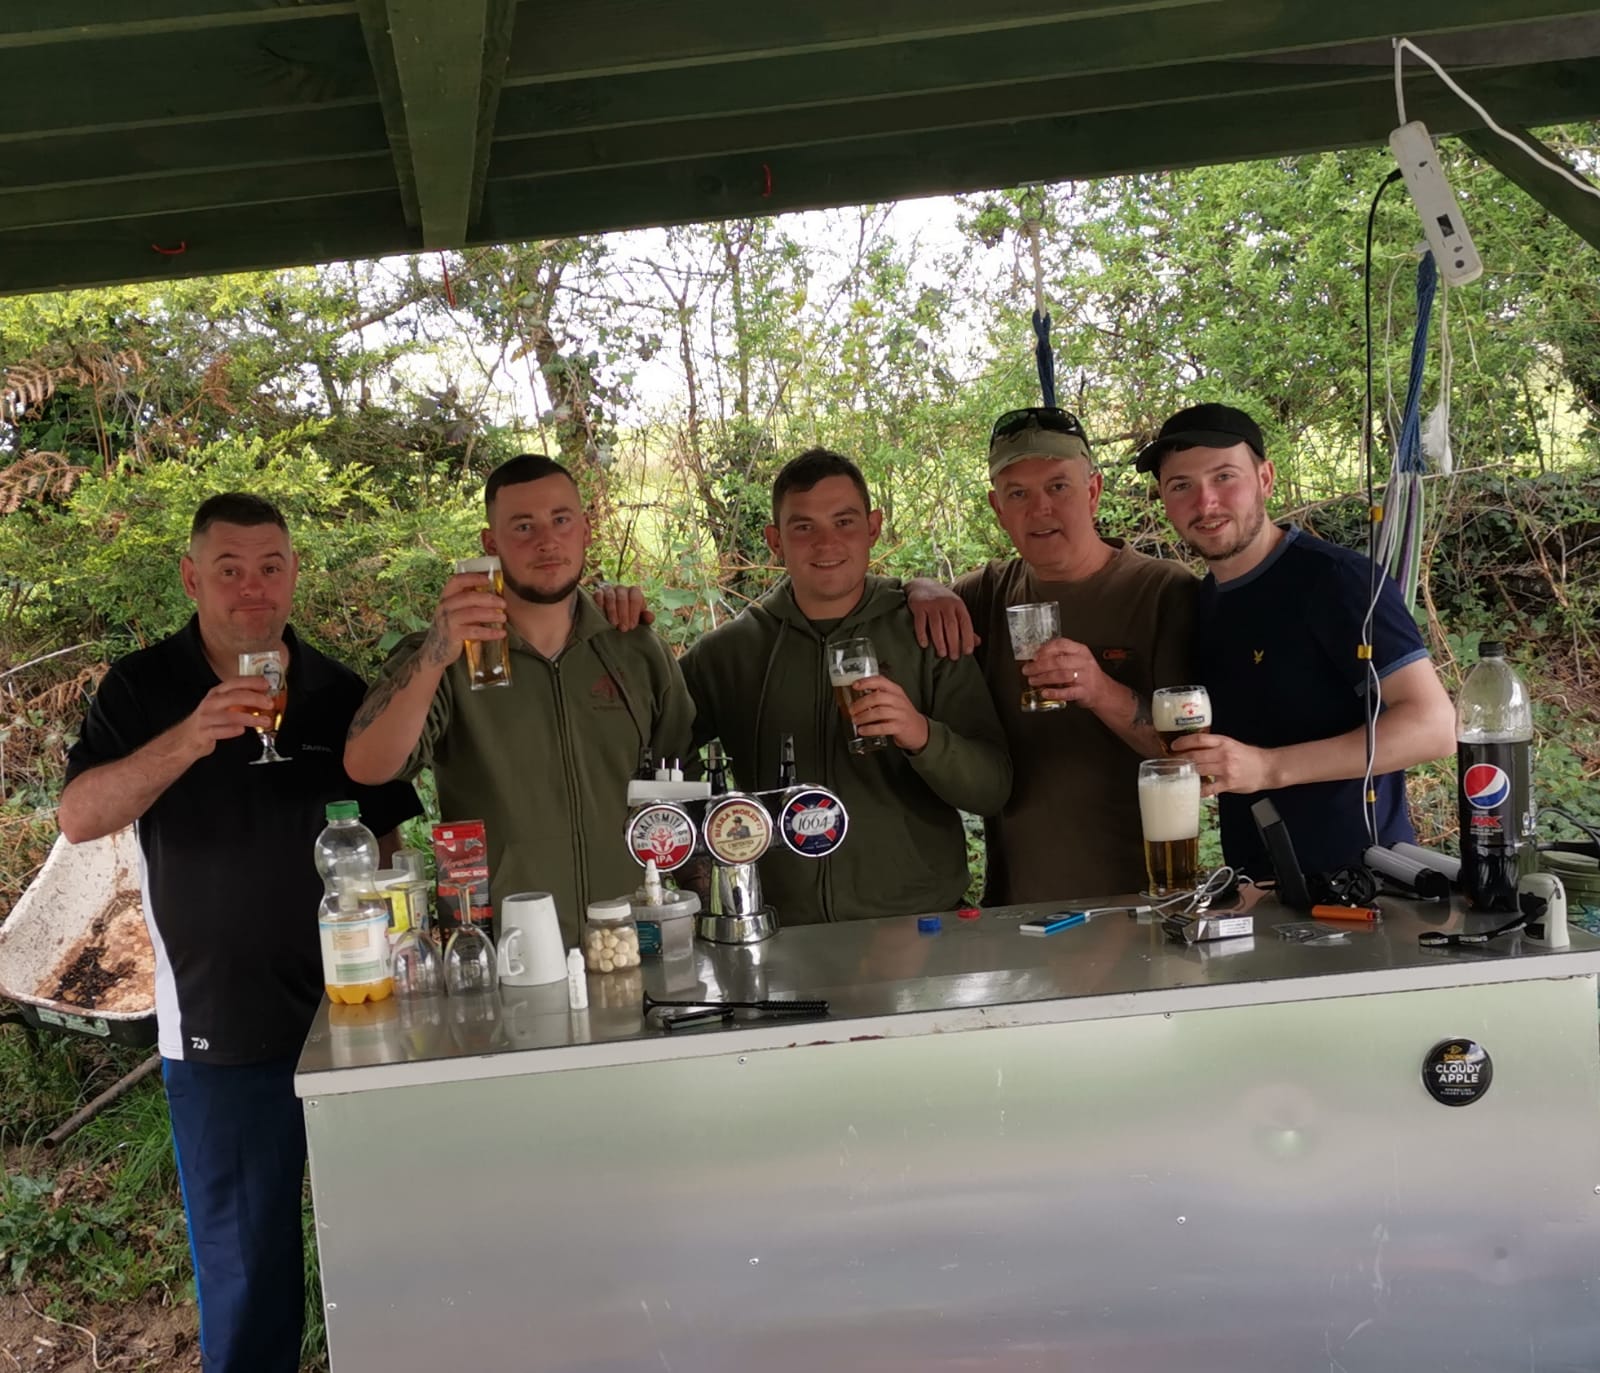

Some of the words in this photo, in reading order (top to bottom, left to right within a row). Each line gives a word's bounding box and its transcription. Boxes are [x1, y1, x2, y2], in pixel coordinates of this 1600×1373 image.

[798, 814, 829, 831] 1664
[655, 855, 674, 864] IPA
[1435, 1064, 1481, 1073] CLOUDY
[1439, 1074, 1479, 1083] APPLE
